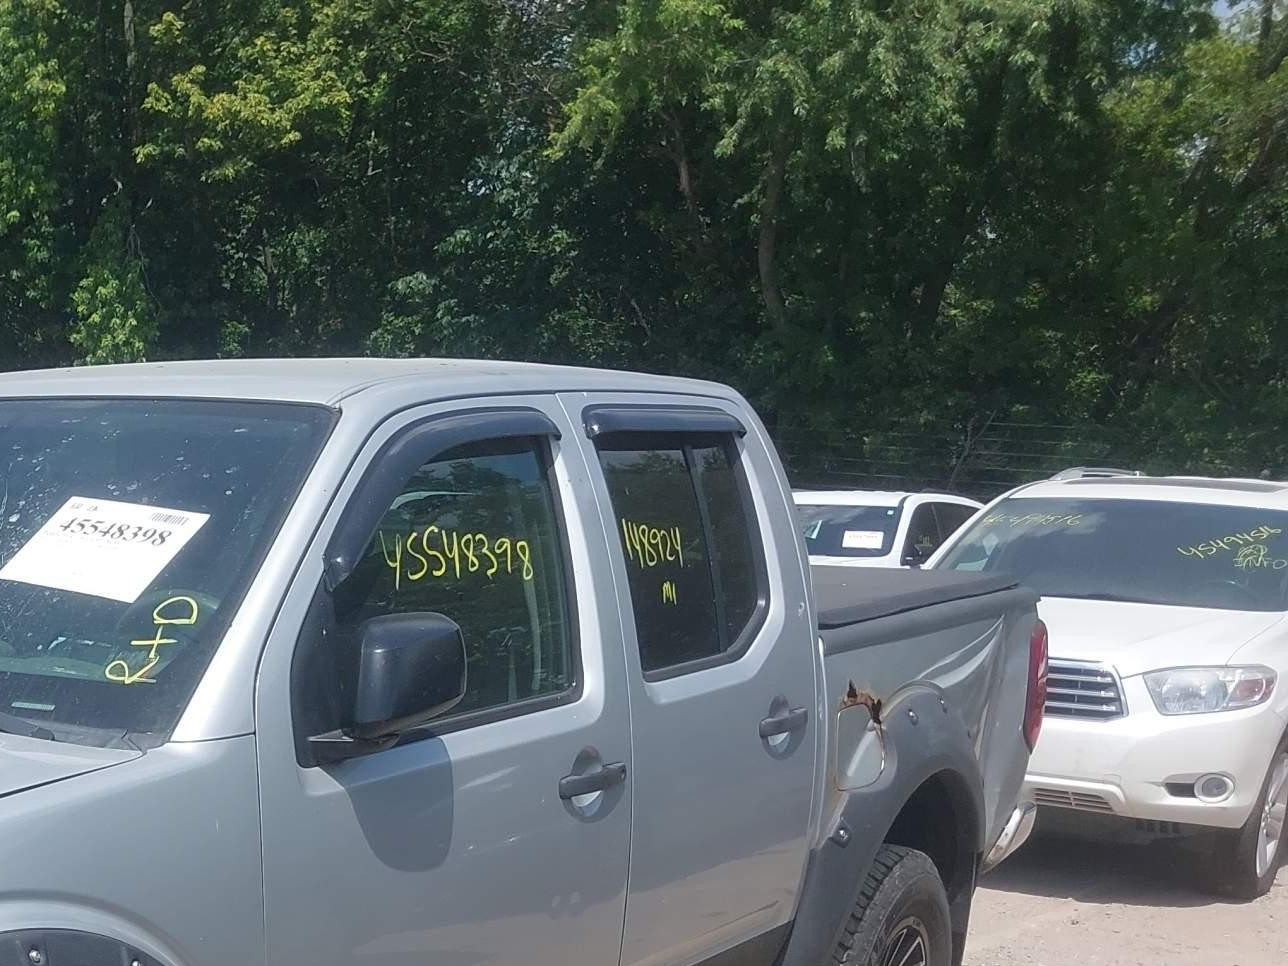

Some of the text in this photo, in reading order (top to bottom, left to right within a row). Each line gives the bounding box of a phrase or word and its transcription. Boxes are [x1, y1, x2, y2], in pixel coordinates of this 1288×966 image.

[60, 517, 172, 546] 45548398
[622, 518, 684, 569] 148924
[379, 525, 534, 591] 45548398
